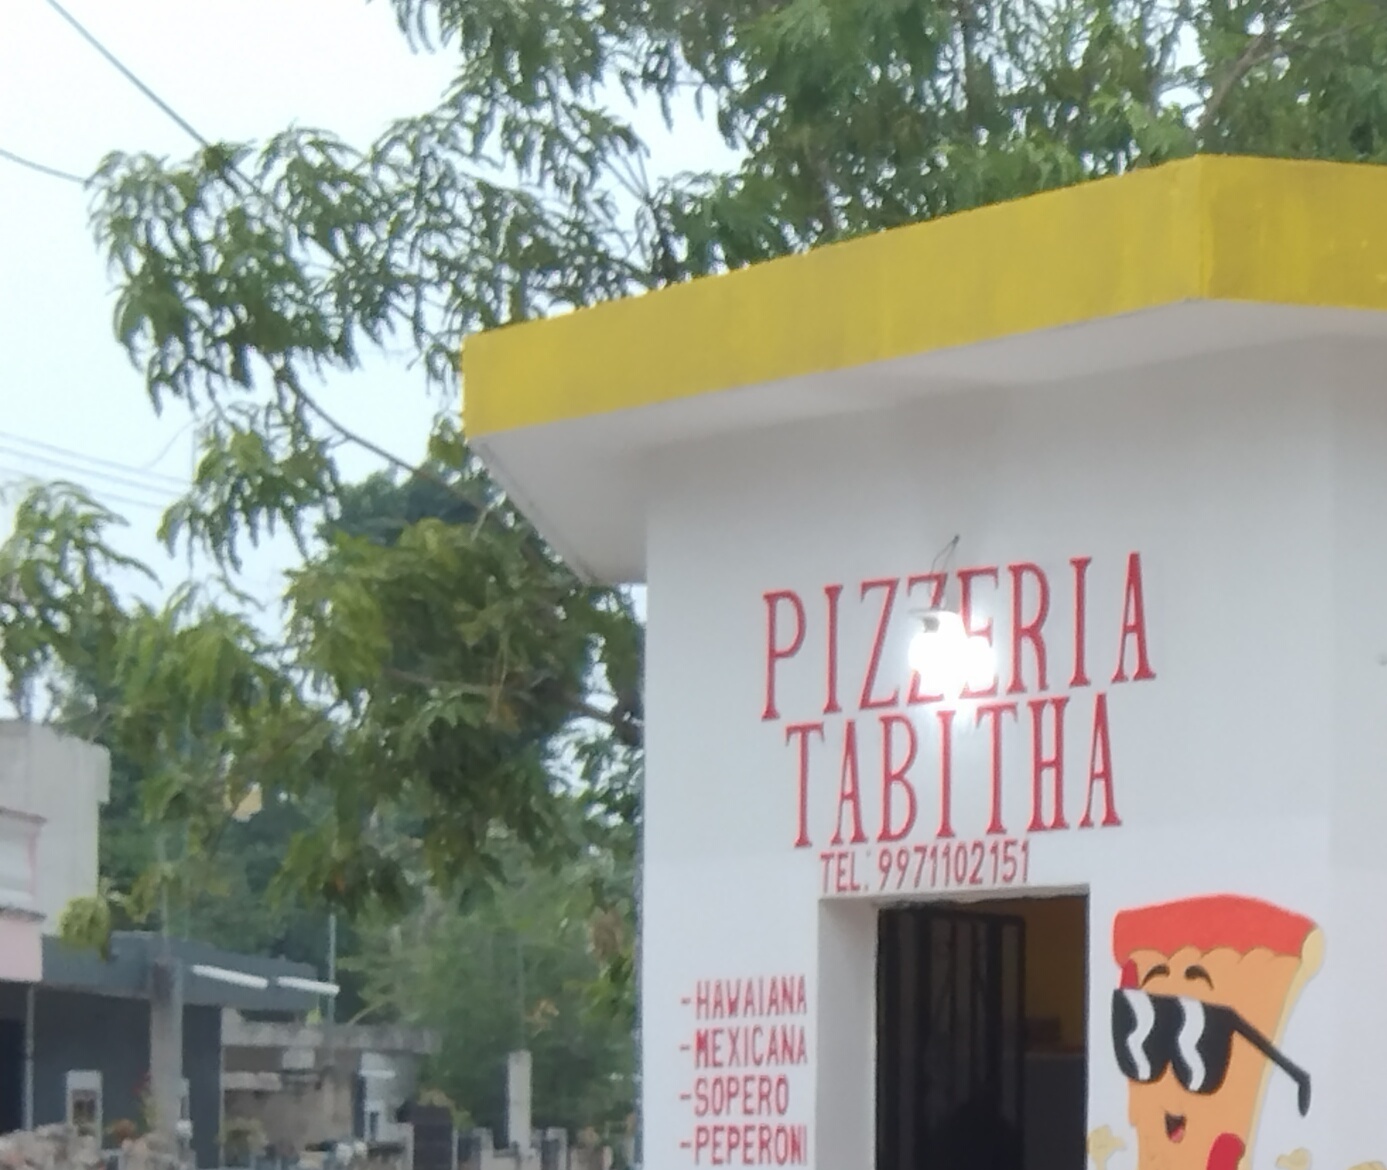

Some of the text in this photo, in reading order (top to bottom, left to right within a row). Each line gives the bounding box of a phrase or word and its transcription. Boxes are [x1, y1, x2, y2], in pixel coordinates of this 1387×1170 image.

[761, 551, 1156, 721] PIZZERIA
[785, 692, 1122, 848] TABITHA
[877, 839, 1029, 890] 9971102151
